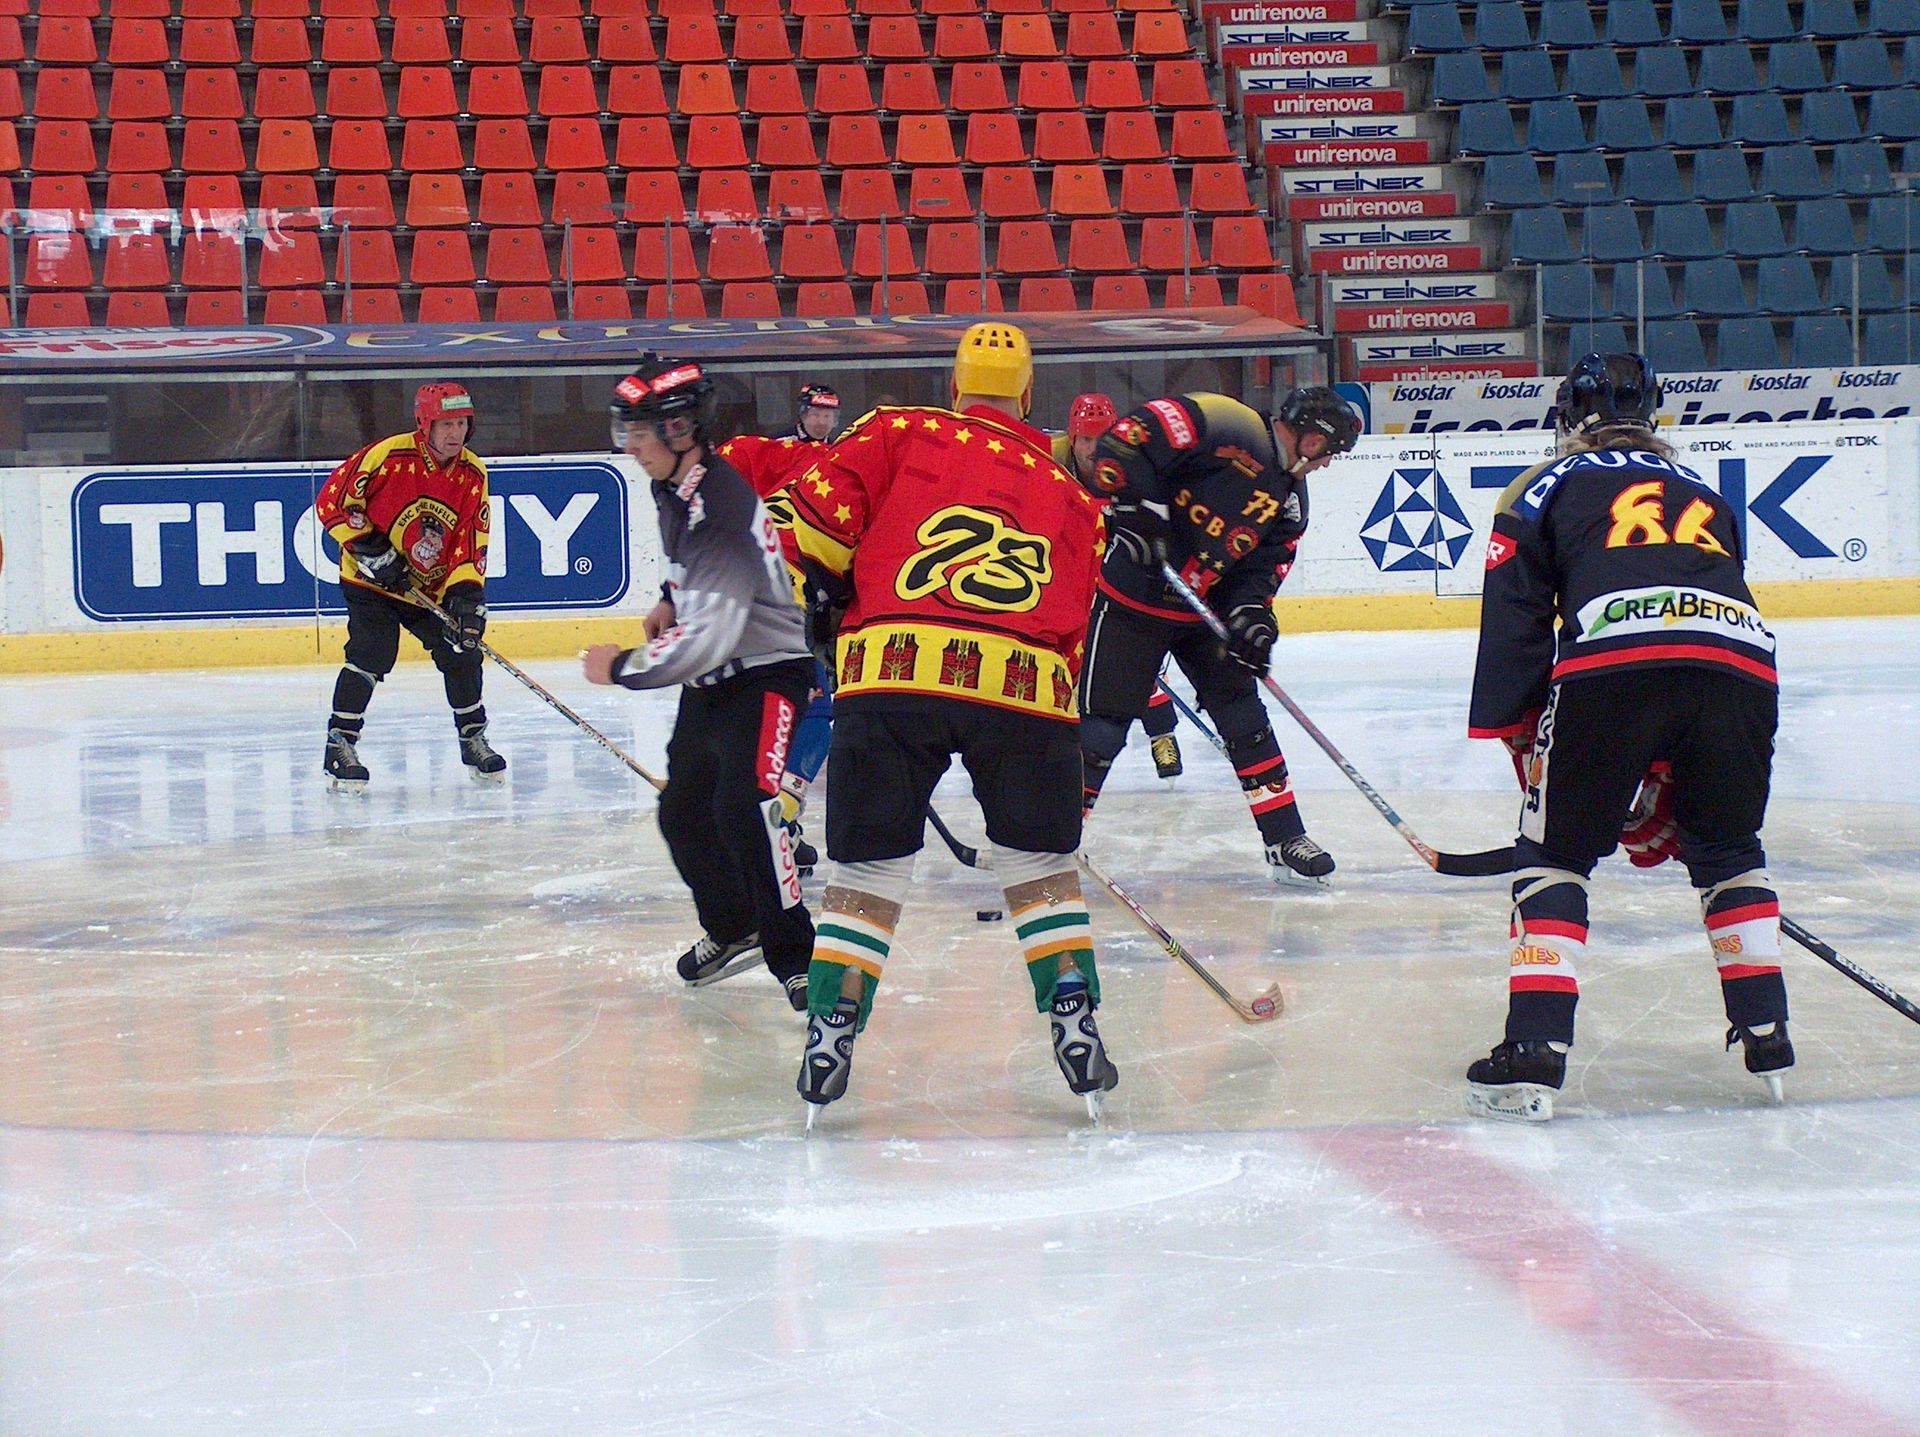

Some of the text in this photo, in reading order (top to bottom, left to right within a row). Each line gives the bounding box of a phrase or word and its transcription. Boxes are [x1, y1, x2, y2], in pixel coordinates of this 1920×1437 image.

[1230, 2, 1327, 21] unirenova
[1250, 46, 1348, 67] unirenova
[1273, 94, 1373, 113] unirenova
[1295, 143, 1396, 164] unirenova
[1320, 196, 1424, 218] unirenova
[1342, 250, 1448, 271] unirenova
[1368, 307, 1476, 330] unirenova
[0, 336, 283, 355] Frisco
[1393, 370, 1902, 401] isostar isostar isostar isostar isostar
[1699, 440, 1732, 452] TDK
[1844, 435, 1878, 447] TDK
[1344, 453, 1368, 461] PLAYED
[1408, 449, 1441, 461] TDK
[1489, 450, 1515, 458] PLAYED
[1516, 449, 1527, 457] ON
[1174, 488, 1226, 538] SCB
[1241, 489, 1280, 525] 77
[398, 509, 415, 528] EHC
[1603, 480, 1732, 558] 86
[99, 492, 600, 588] THY
[763, 700, 793, 794] Adecco
